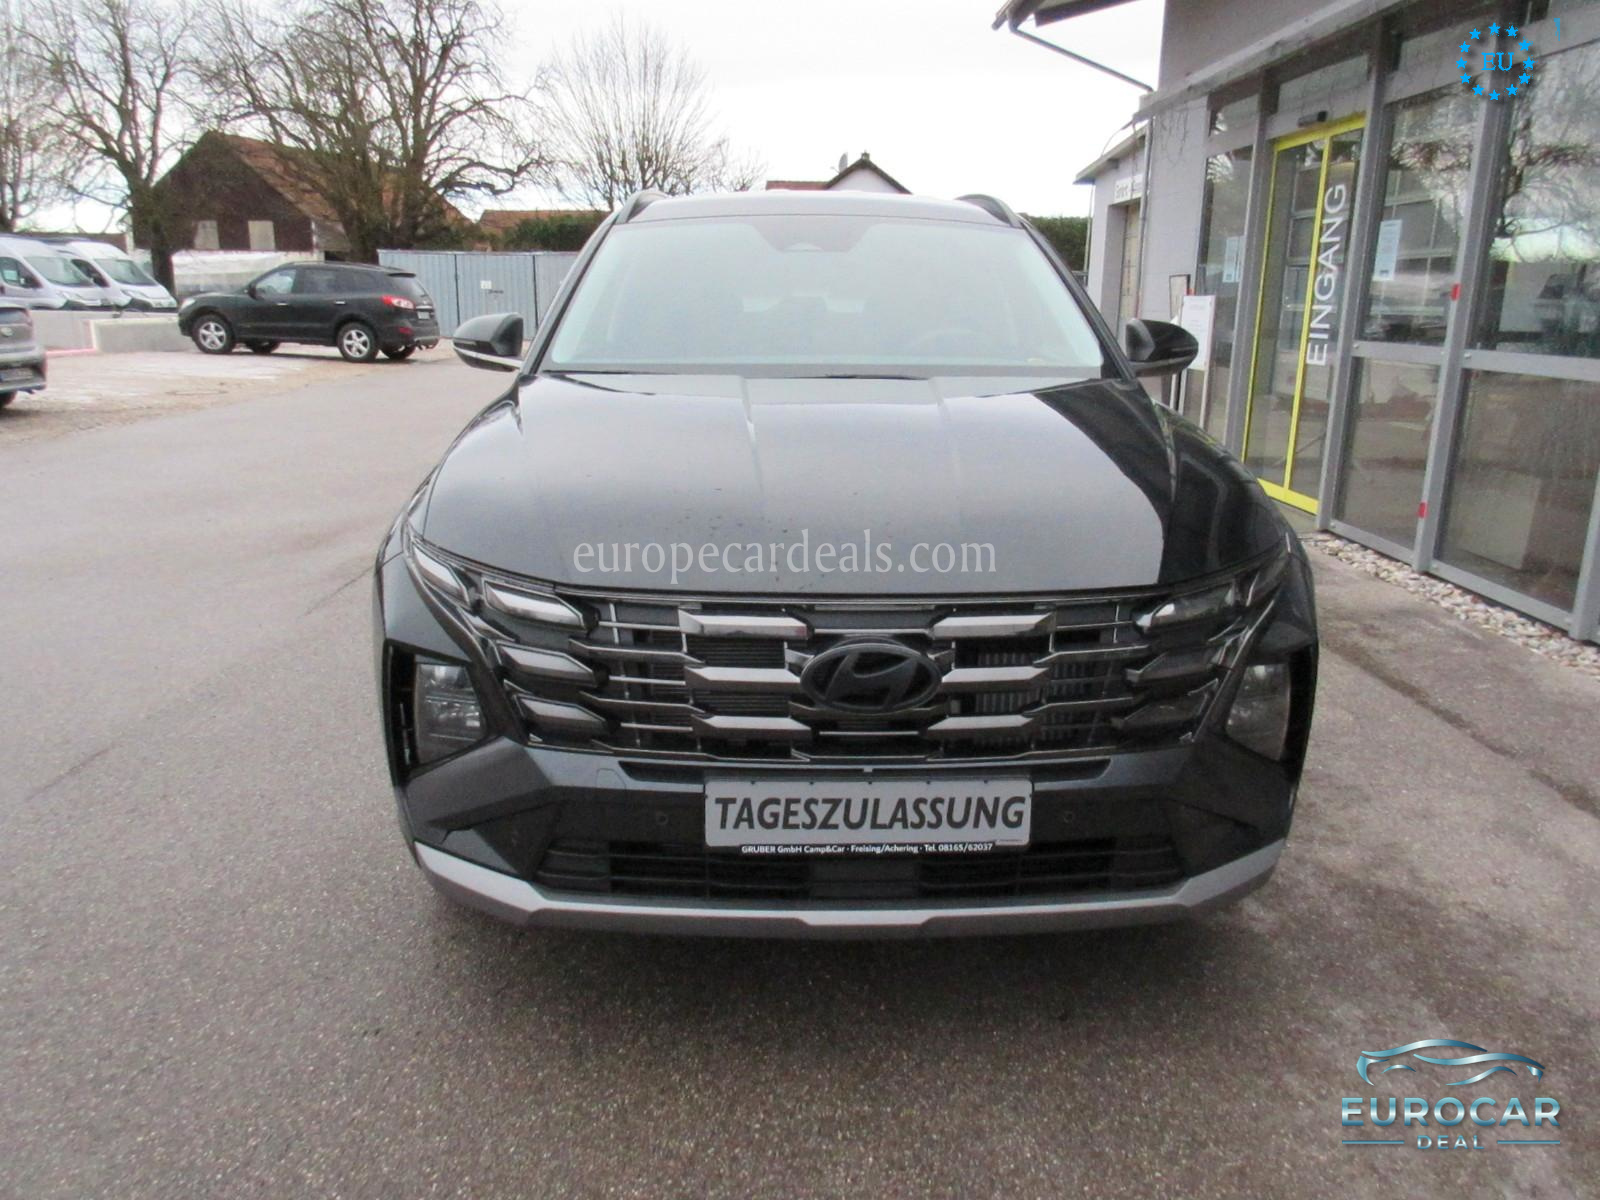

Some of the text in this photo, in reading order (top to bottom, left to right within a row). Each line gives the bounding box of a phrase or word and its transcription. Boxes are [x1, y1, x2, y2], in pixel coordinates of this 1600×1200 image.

[1306, 184, 1347, 367] EINGANG
[715, 796, 1026, 831] TAGESZULASSUNG
[741, 845, 776, 854] GRUBER
[777, 845, 803, 854] GmbH
[804, 845, 845, 855] Camp&Car
